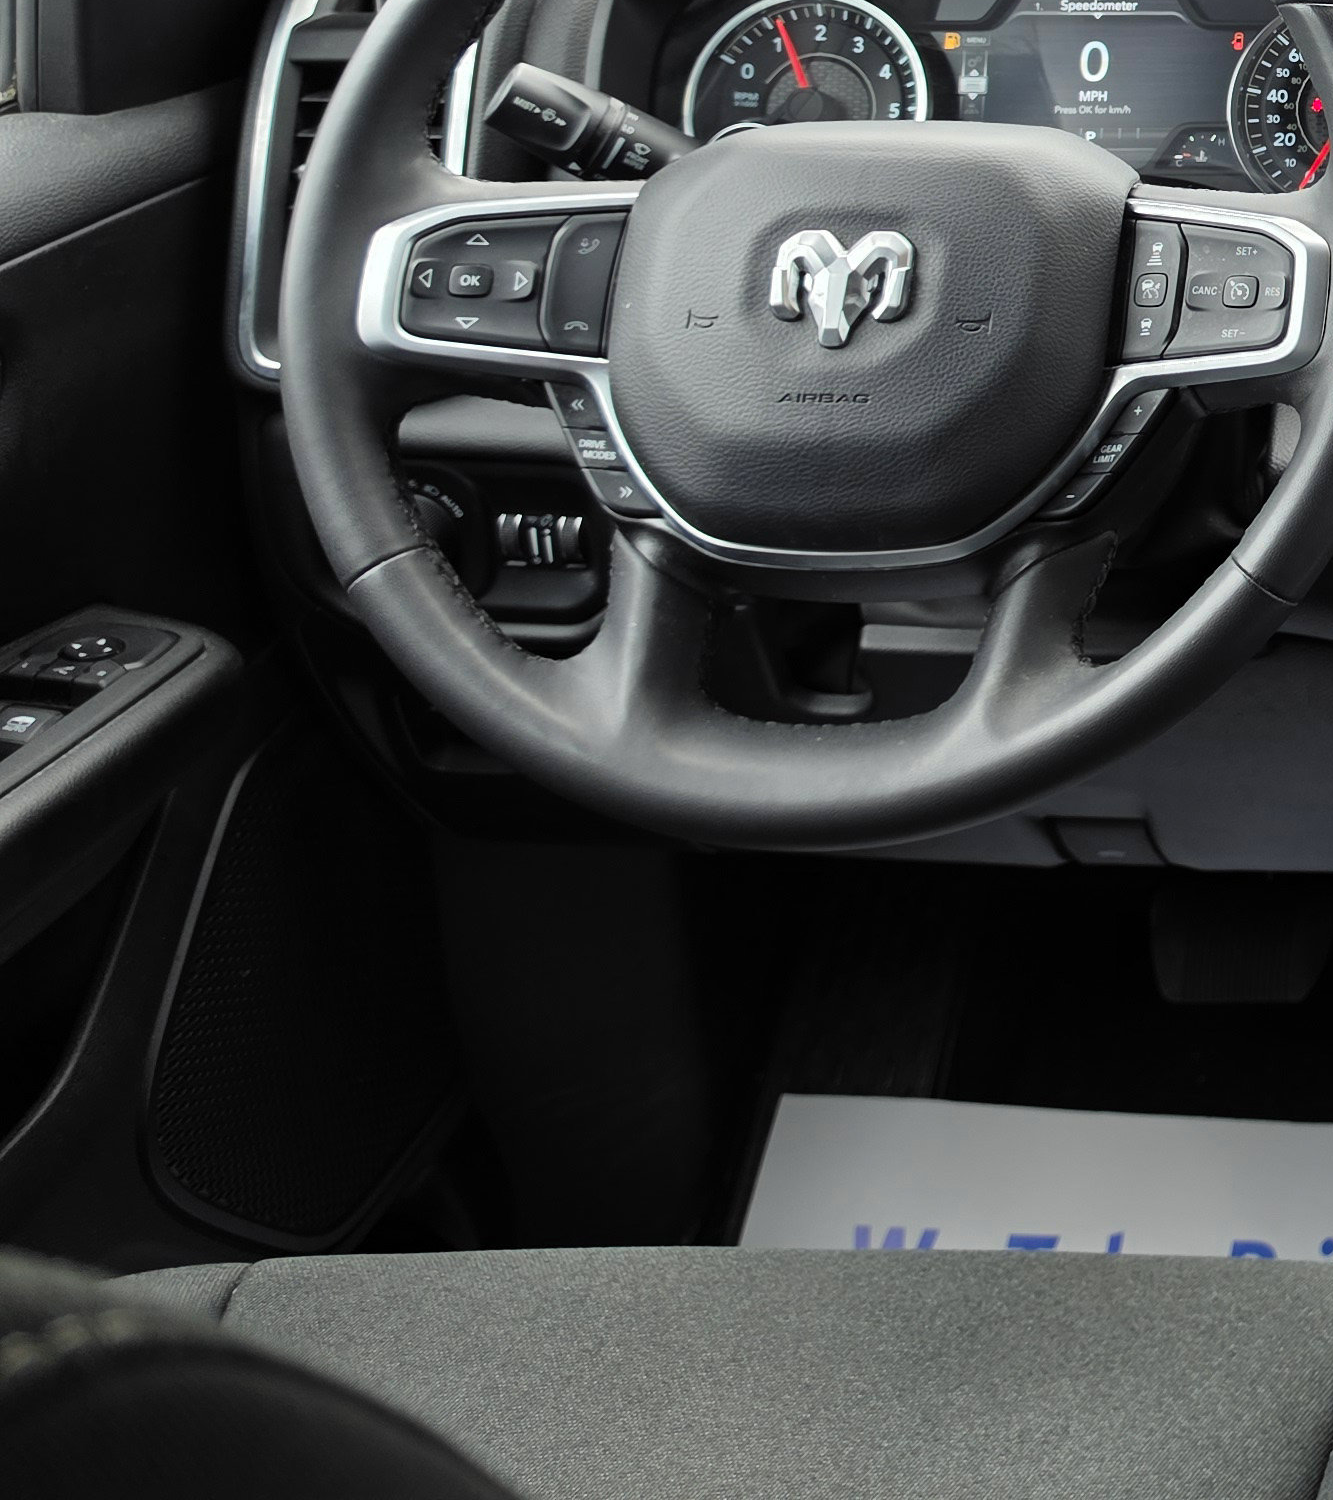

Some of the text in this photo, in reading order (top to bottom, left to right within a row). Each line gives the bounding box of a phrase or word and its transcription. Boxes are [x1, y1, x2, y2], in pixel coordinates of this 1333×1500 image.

[1060, 0, 1139, 13] Speedometer
[814, 24, 828, 42] 2
[772, 37, 782, 53] 1
[853, 36, 865, 54] 3
[1080, 40, 1110, 82] 0
[739, 63, 755, 80] 0
[879, 64, 892, 80] 4
[1276, 68, 1290, 78] 50
[1079, 90, 1108, 102] MPH
[1266, 89, 1289, 104] 40
[888, 103, 900, 119] 5
[1054, 105, 1078, 115] Press
[1079, 105, 1093, 115] OK
[1095, 105, 1107, 115] for
[1266, 114, 1281, 124] 30
[1273, 132, 1296, 147] 20
[1284, 158, 1297, 168] 10
[1236, 246, 1258, 257] SET+
[460, 274, 481, 287] OK
[1264, 287, 1281, 297] RES
[777, 392, 871, 404] AIRBAG
[578, 439, 608, 449] DRIVE
[1101, 443, 1123, 453] GEAR
[582, 450, 617, 461] MODES
[1093, 454, 1116, 464] LIMIT
